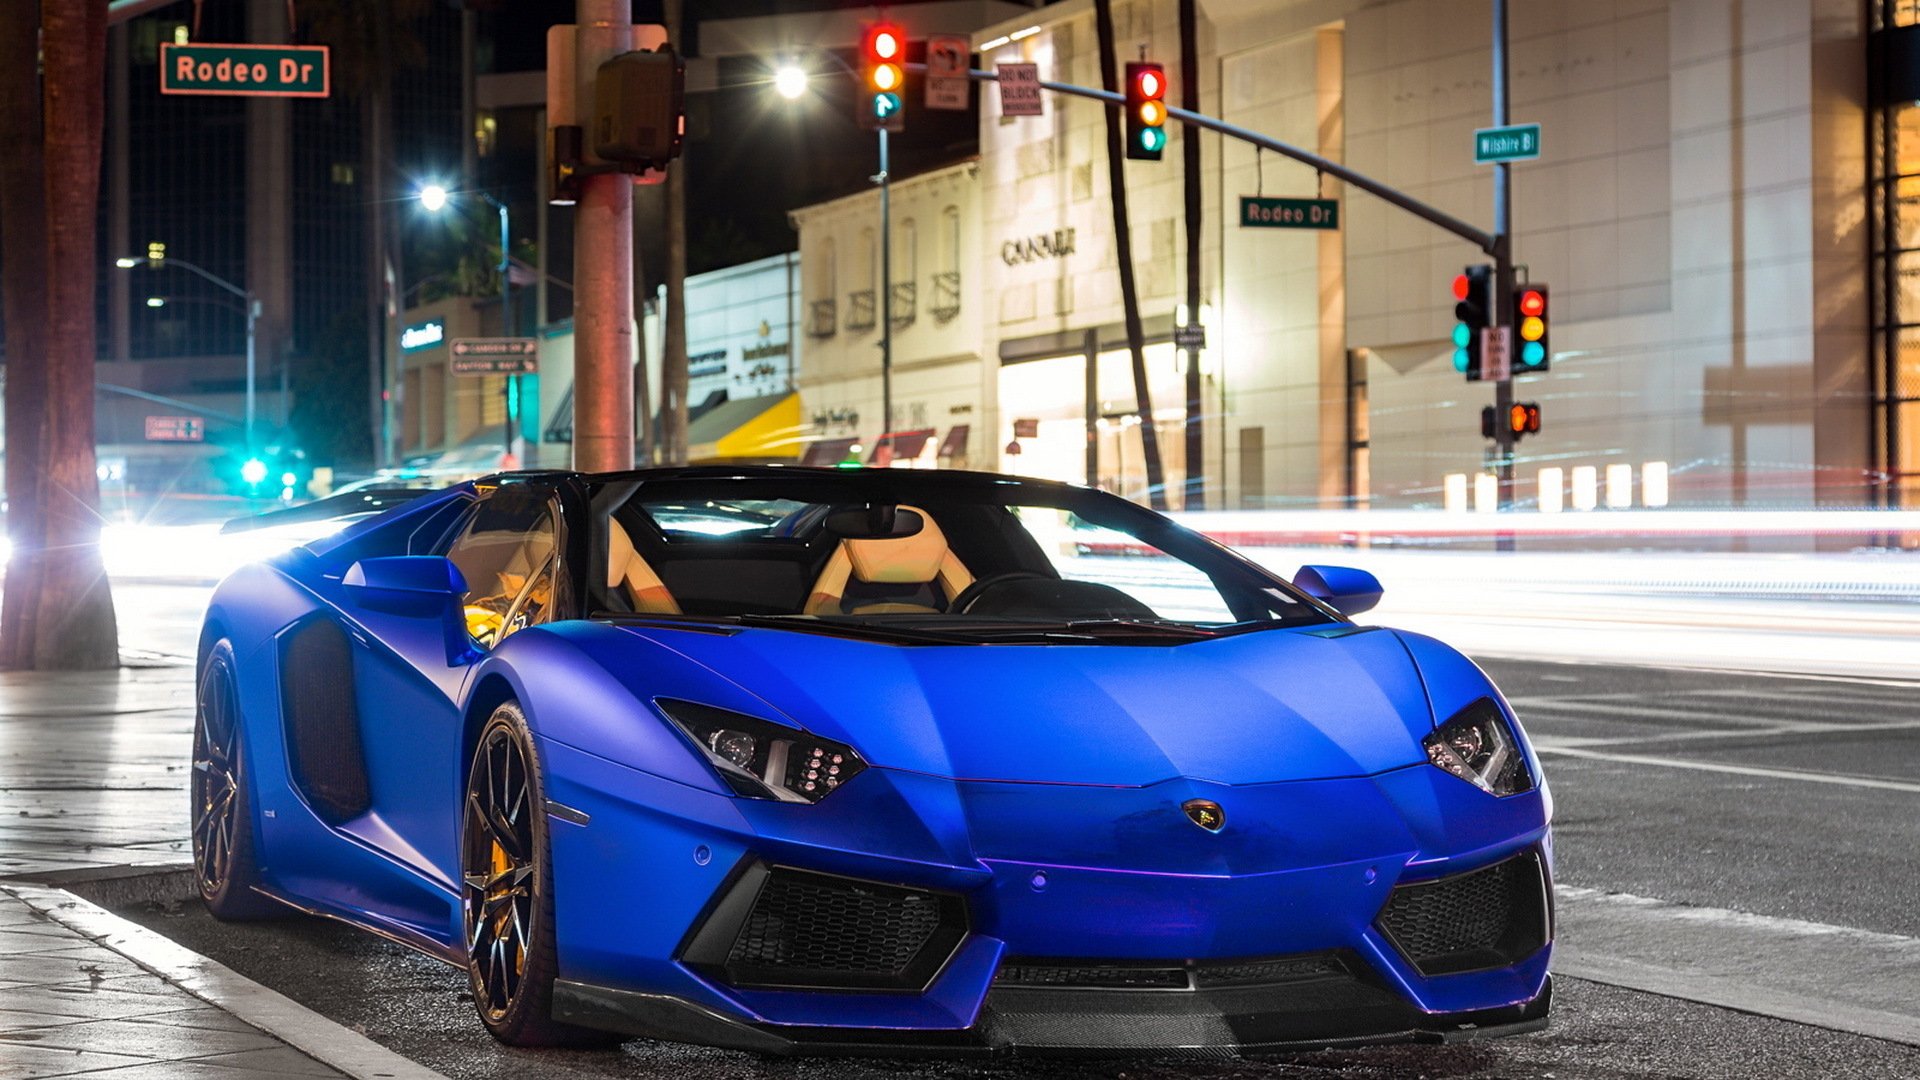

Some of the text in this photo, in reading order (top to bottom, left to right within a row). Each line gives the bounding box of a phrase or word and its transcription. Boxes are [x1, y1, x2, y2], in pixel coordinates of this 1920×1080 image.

[177, 56, 314, 84] Rodeo Dr
[1003, 87, 1040, 99] BLOCK
[1482, 135, 1520, 155] Wilshire
[1247, 202, 1332, 223] Rodeo Dr
